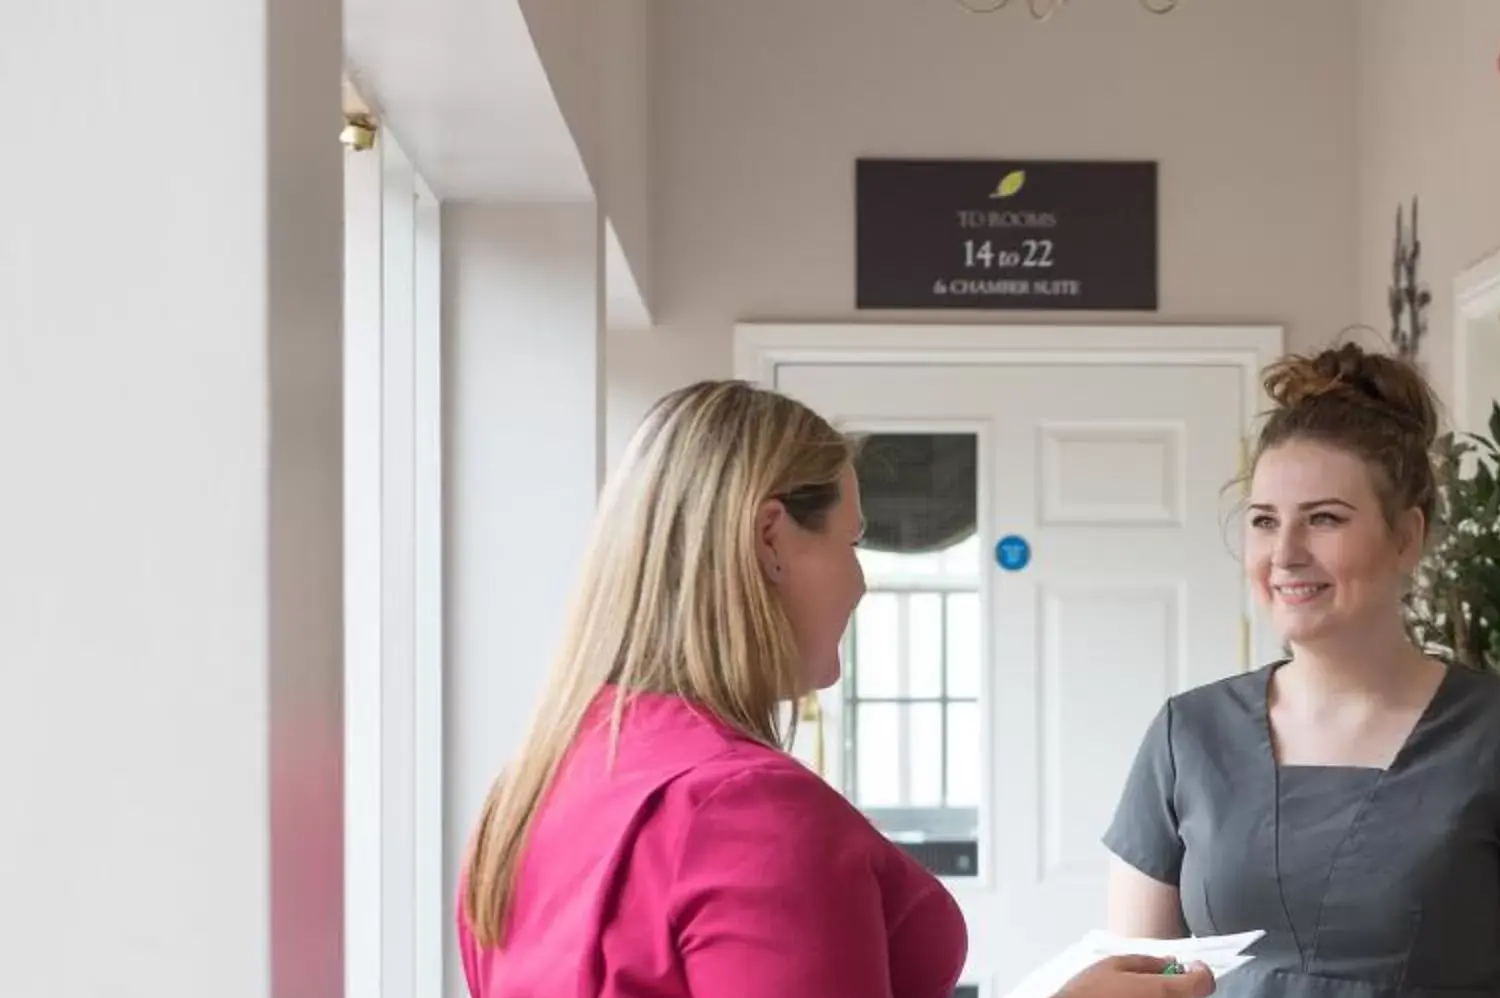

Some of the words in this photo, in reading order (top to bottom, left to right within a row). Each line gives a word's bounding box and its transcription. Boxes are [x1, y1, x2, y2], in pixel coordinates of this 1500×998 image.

[957, 211, 985, 228] TO
[988, 211, 1056, 228] ROOMS
[964, 239, 993, 268] 14
[998, 250, 1020, 267] to
[1022, 239, 1053, 267] 22
[950, 280, 1029, 294] CHAMBER
[1034, 280, 1081, 295] SUITE
